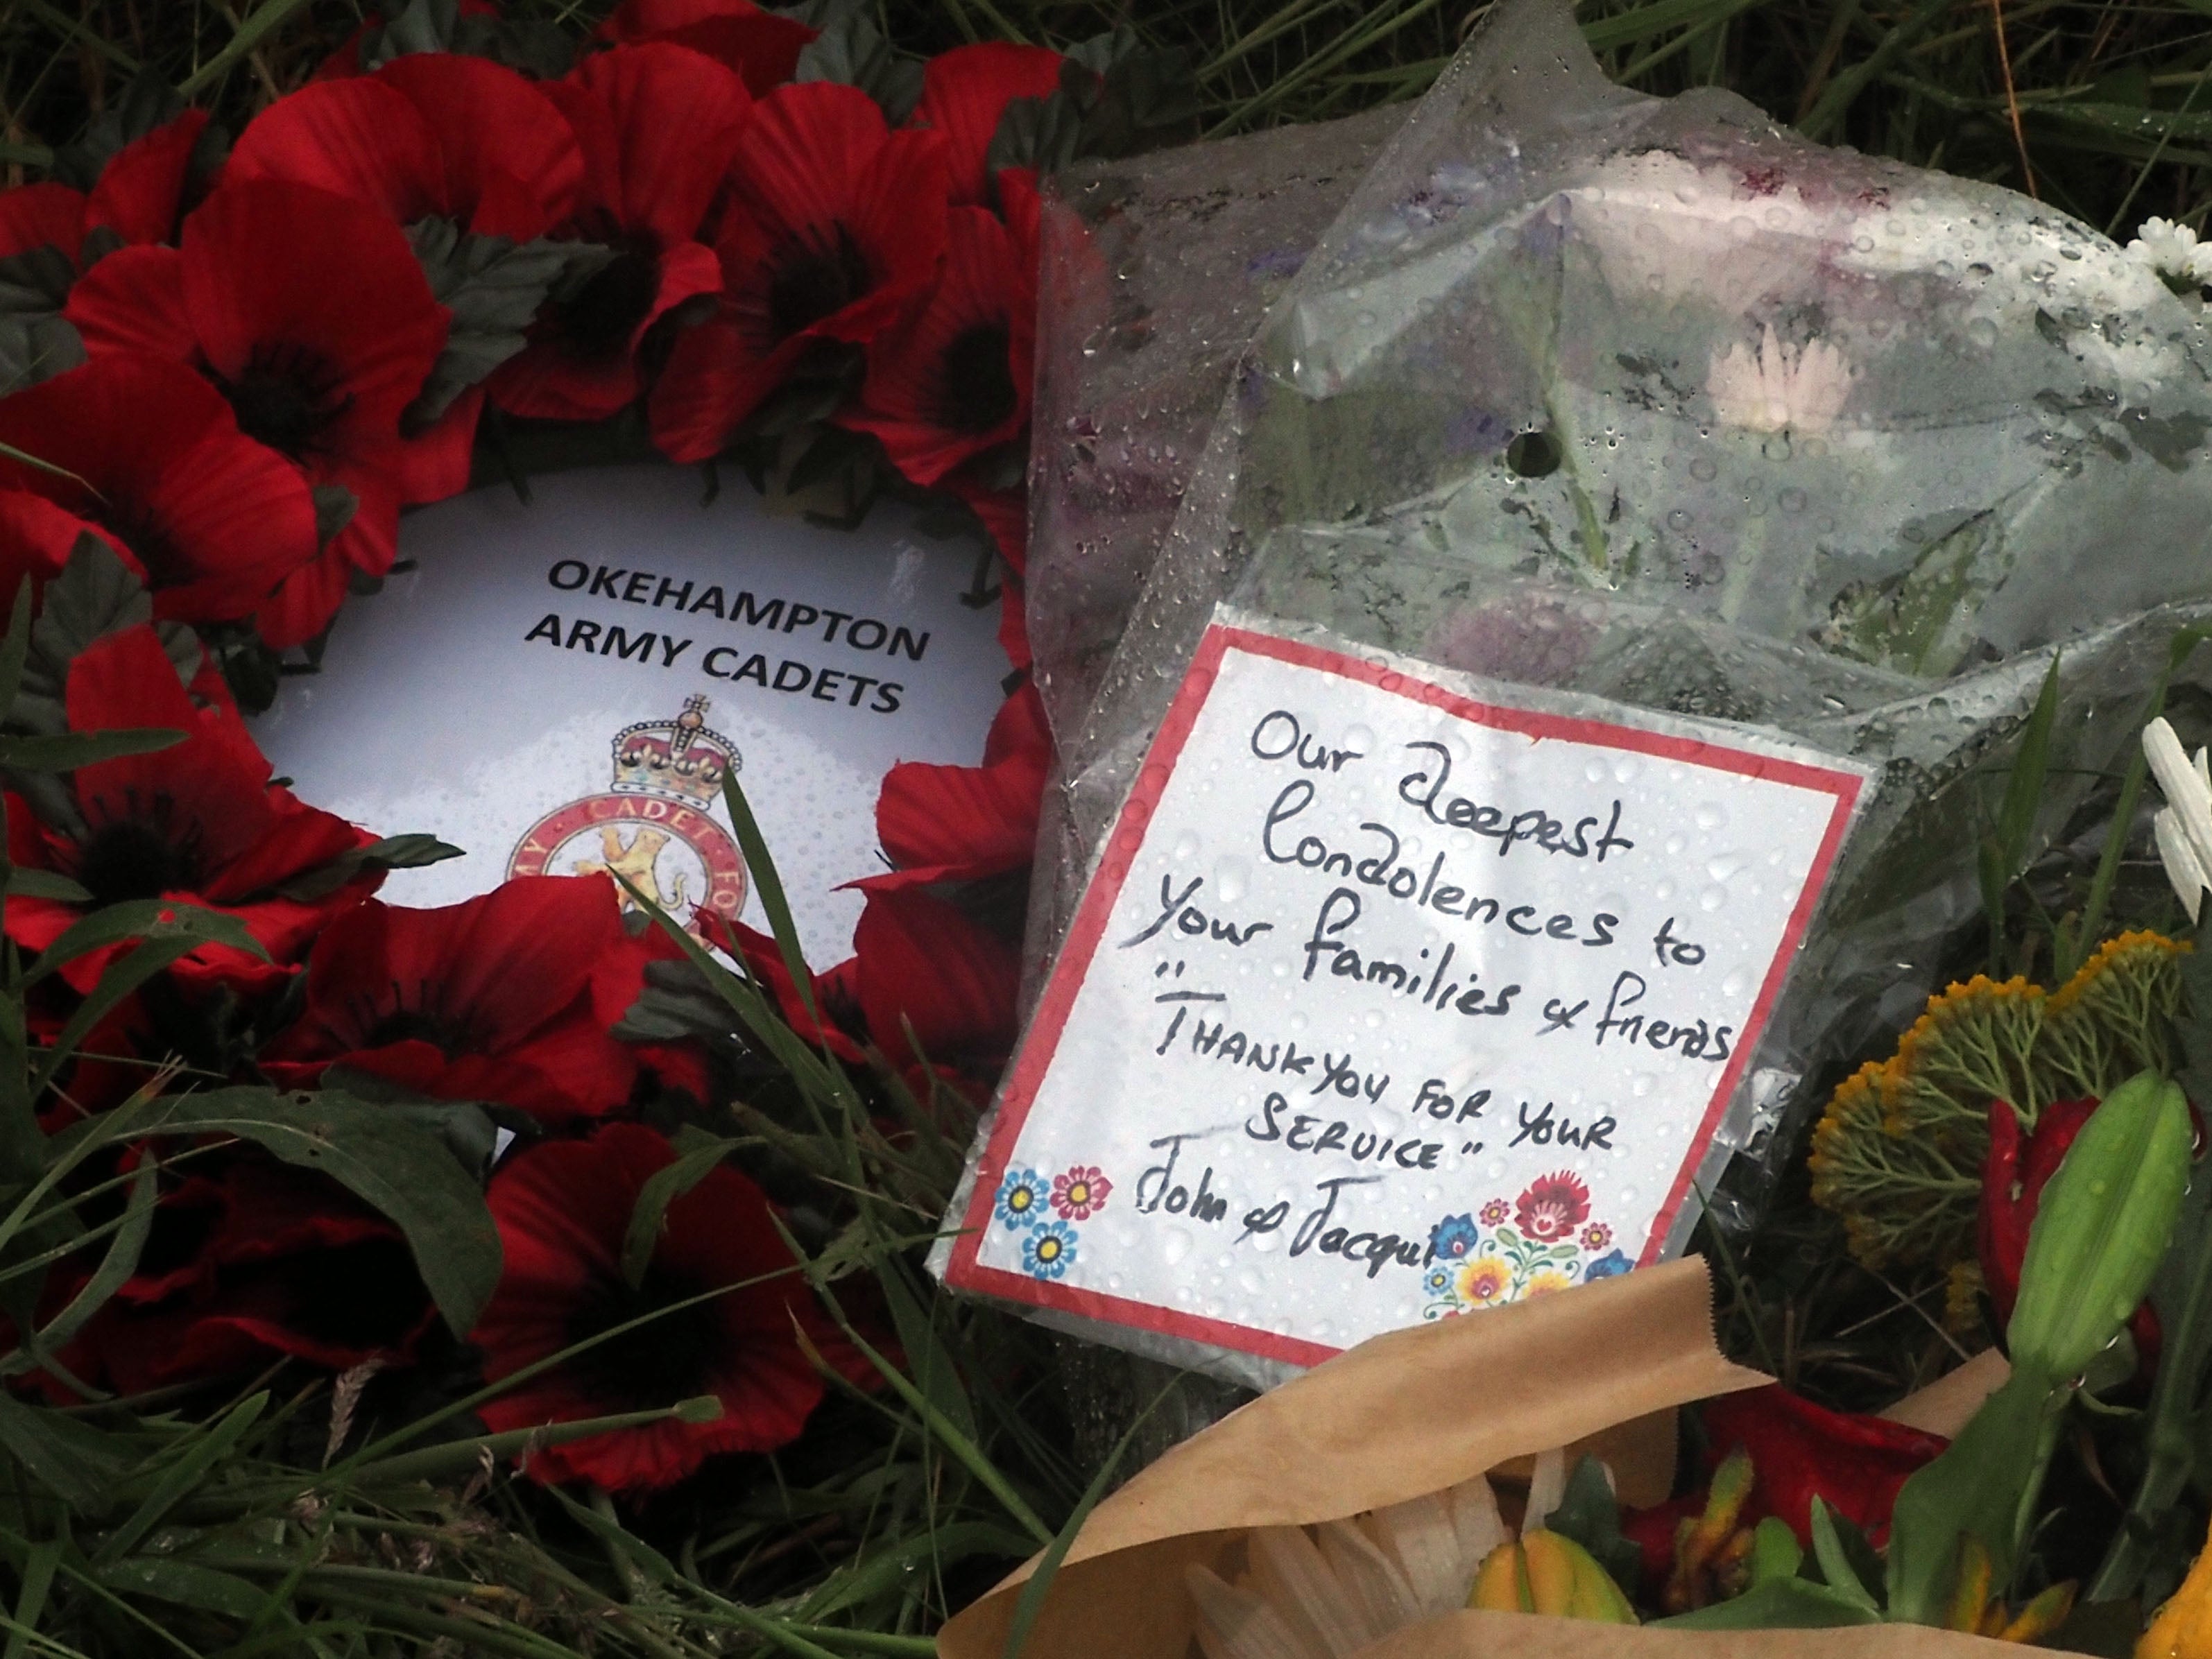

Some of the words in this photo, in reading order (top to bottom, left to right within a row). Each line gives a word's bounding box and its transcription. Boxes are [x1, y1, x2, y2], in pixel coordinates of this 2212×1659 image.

[549, 560, 930, 661] OKEHAMPTON
[524, 614, 693, 668] ARMY
[702, 646, 904, 714] CADETS
[1251, 710, 1364, 773] Our
[590, 797, 716, 841] CADET
[1652, 916, 1706, 968] to
[1536, 997, 1590, 1036] &
[1411, 1078, 1492, 1124] FOR
[1135, 1132, 1228, 1223] John
[1233, 1201, 1291, 1245] &
[1289, 1175, 1440, 1280] Jacqui
